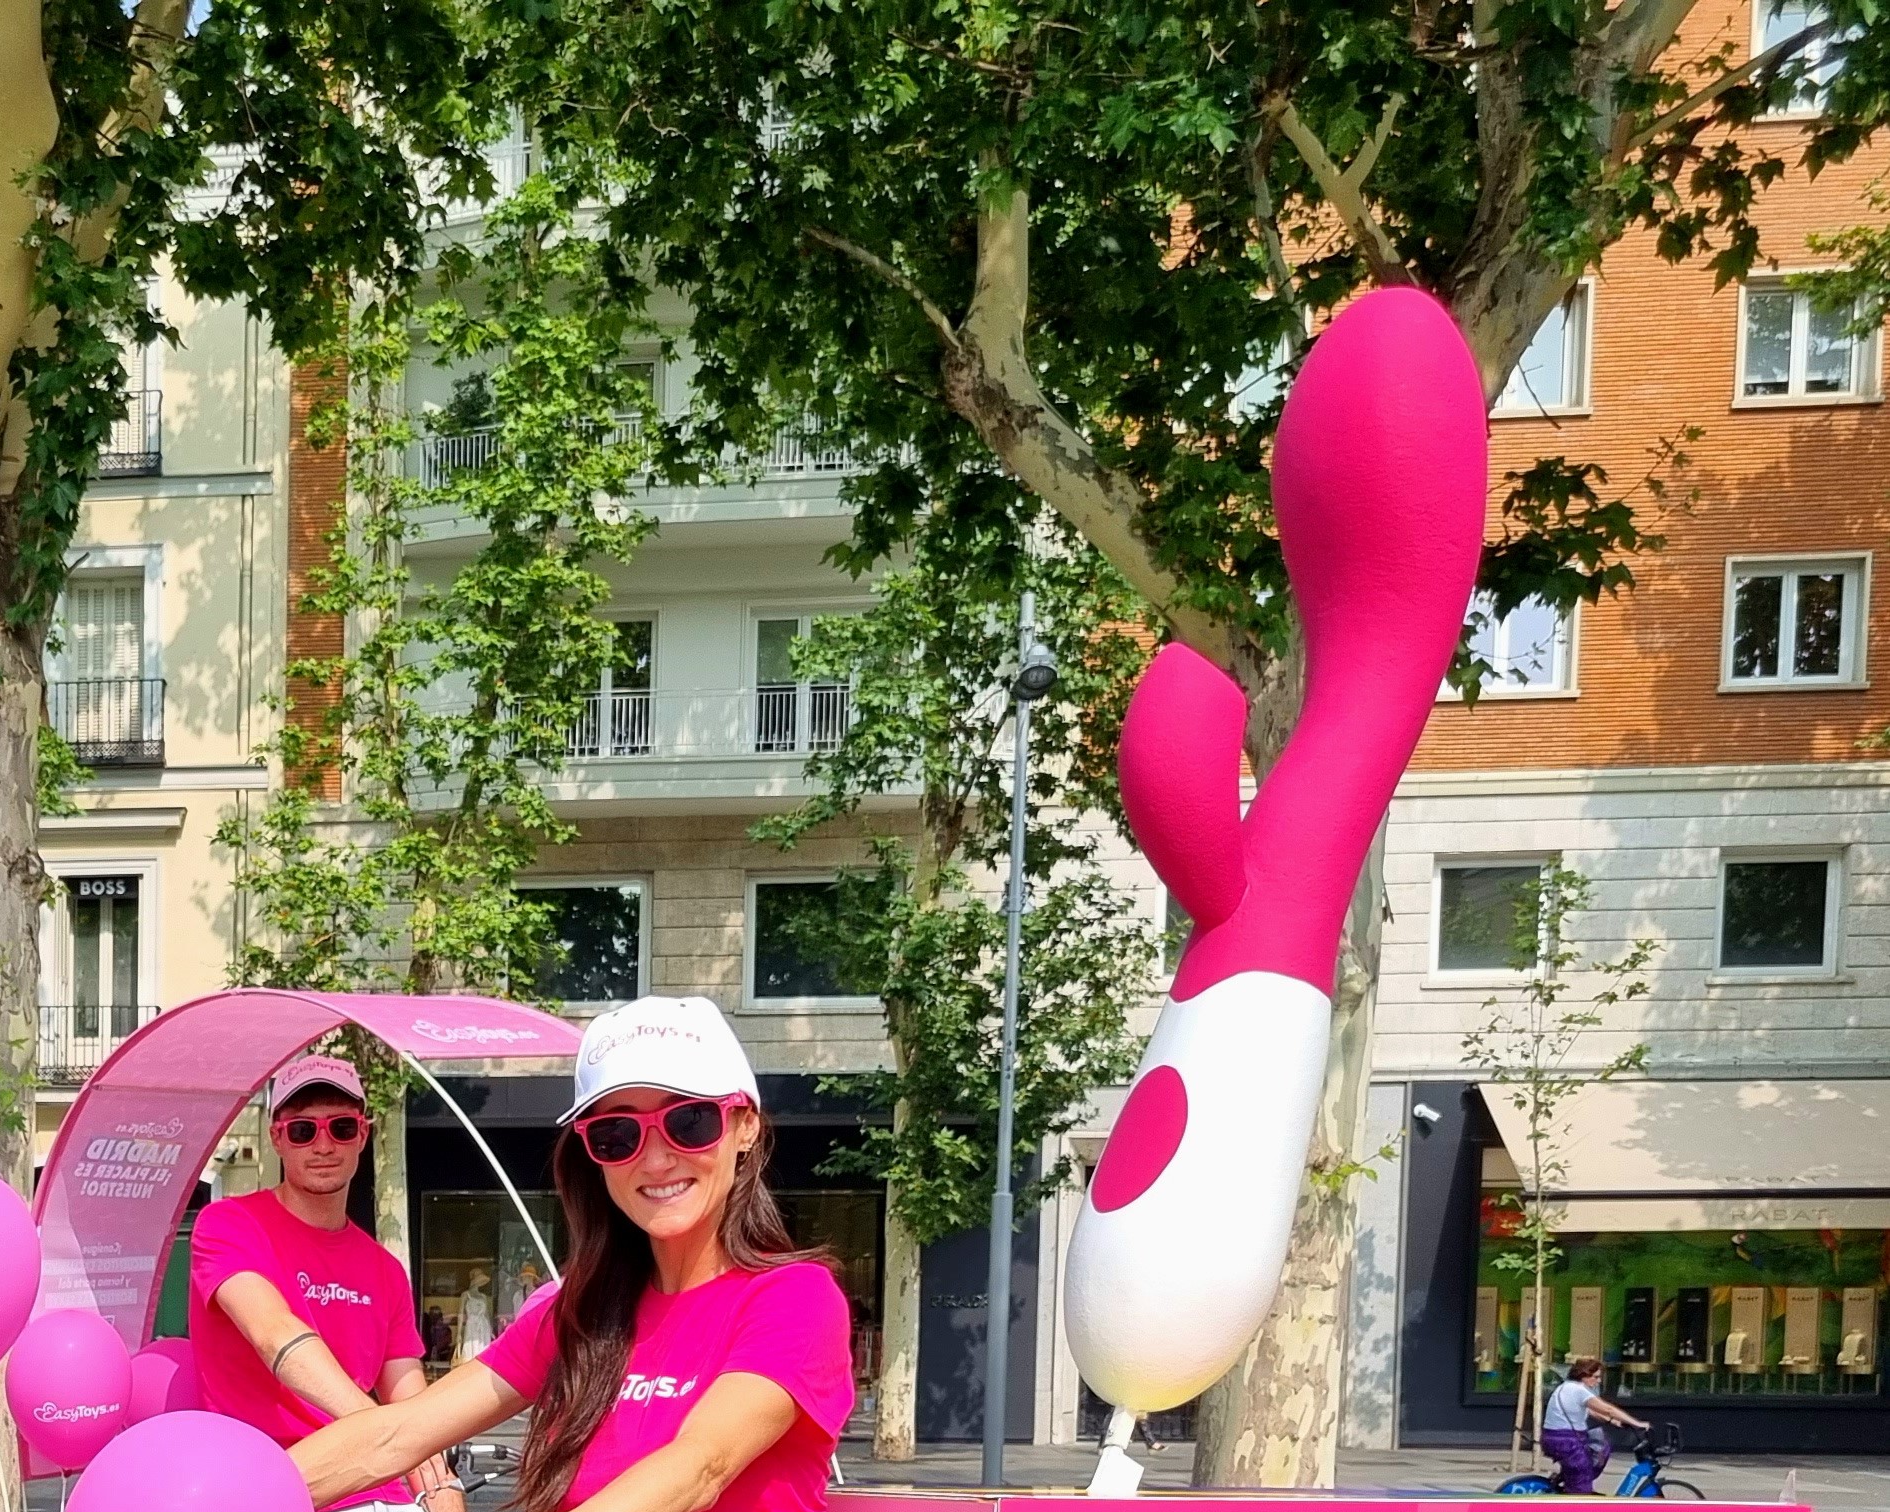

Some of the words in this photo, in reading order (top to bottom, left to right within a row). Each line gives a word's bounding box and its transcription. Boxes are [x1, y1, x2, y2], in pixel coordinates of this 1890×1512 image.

[80, 880, 126, 896] BOSS
[1731, 1208, 1829, 1221] RABAT
[33, 1401, 120, 1423] EasyToys.es
